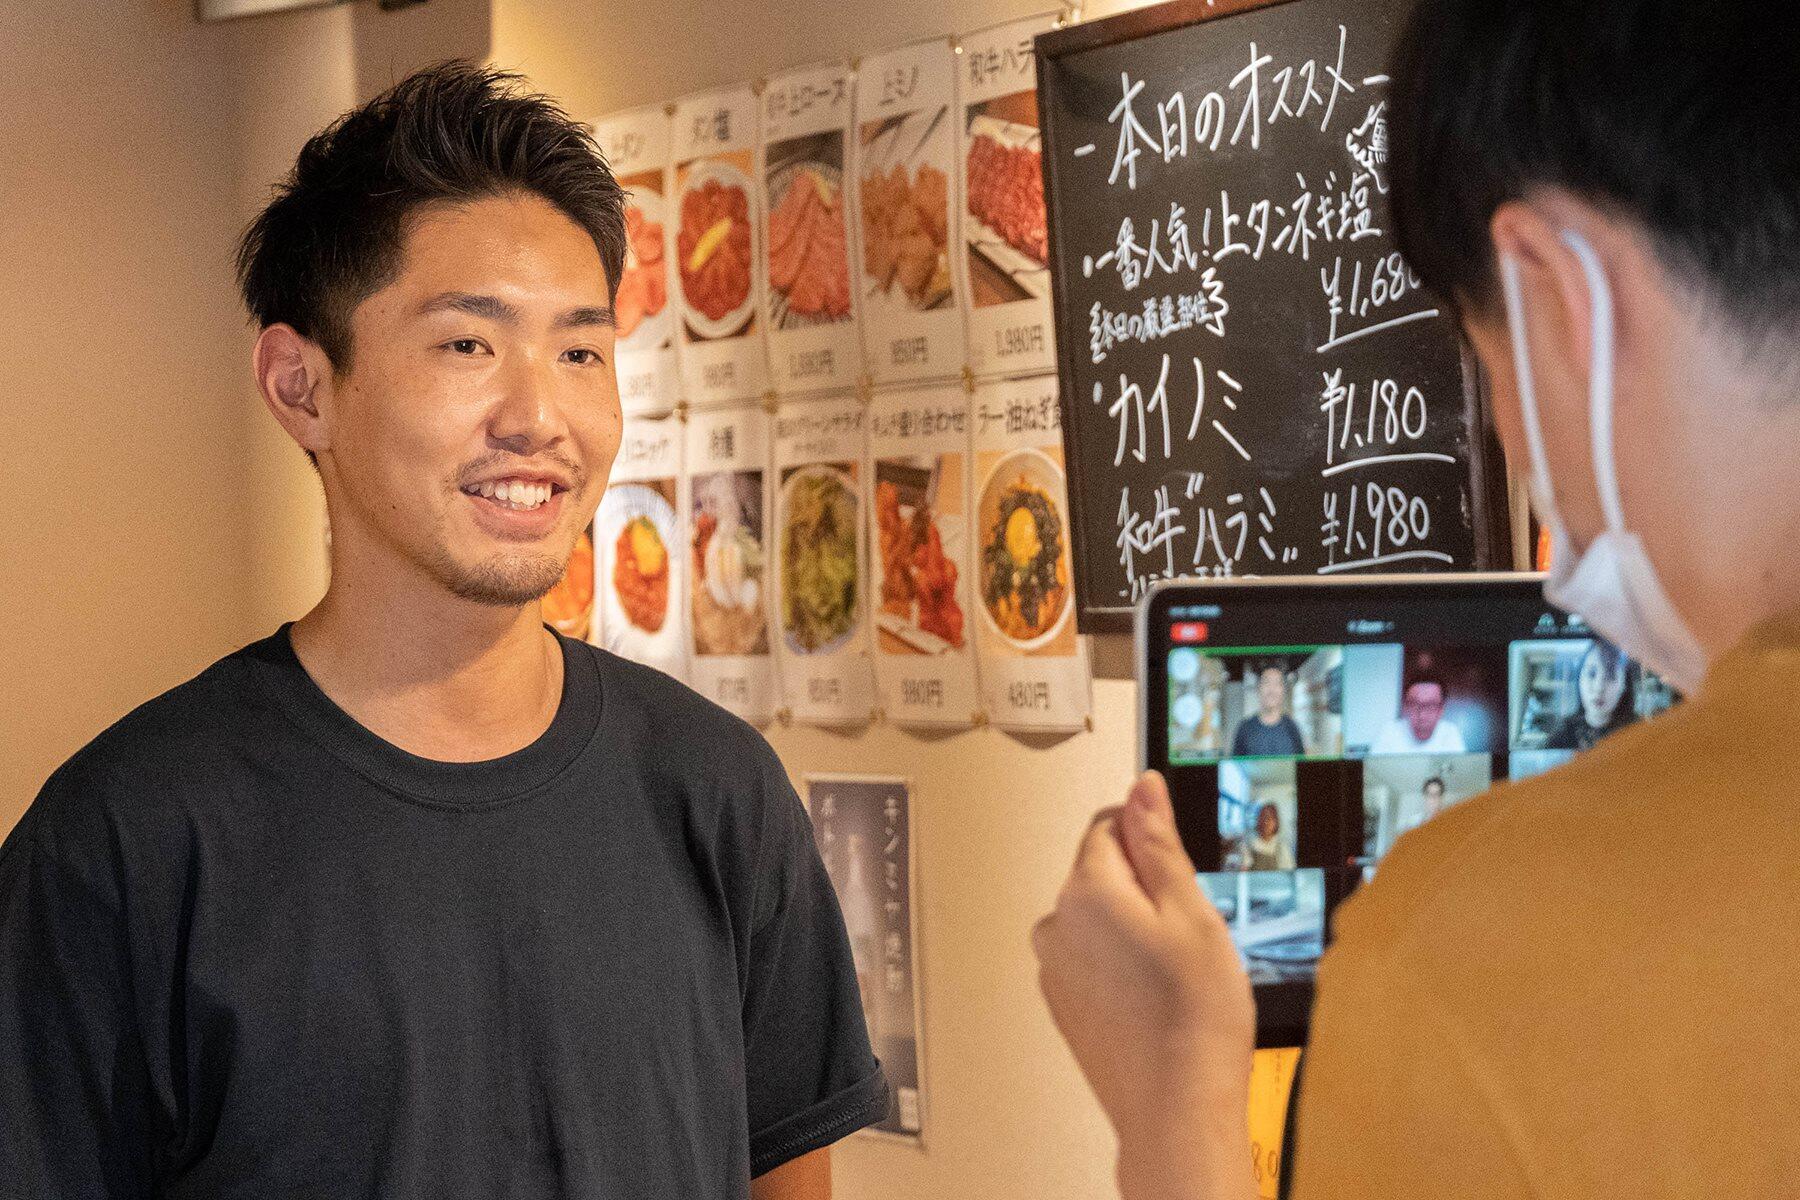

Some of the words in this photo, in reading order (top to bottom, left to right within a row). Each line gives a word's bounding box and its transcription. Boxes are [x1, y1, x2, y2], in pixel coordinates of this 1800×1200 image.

[1108, 353, 1251, 467] カイノミ
[1320, 367, 1428, 464] ¥1,180
[1320, 481, 1431, 566] ¥1,980
